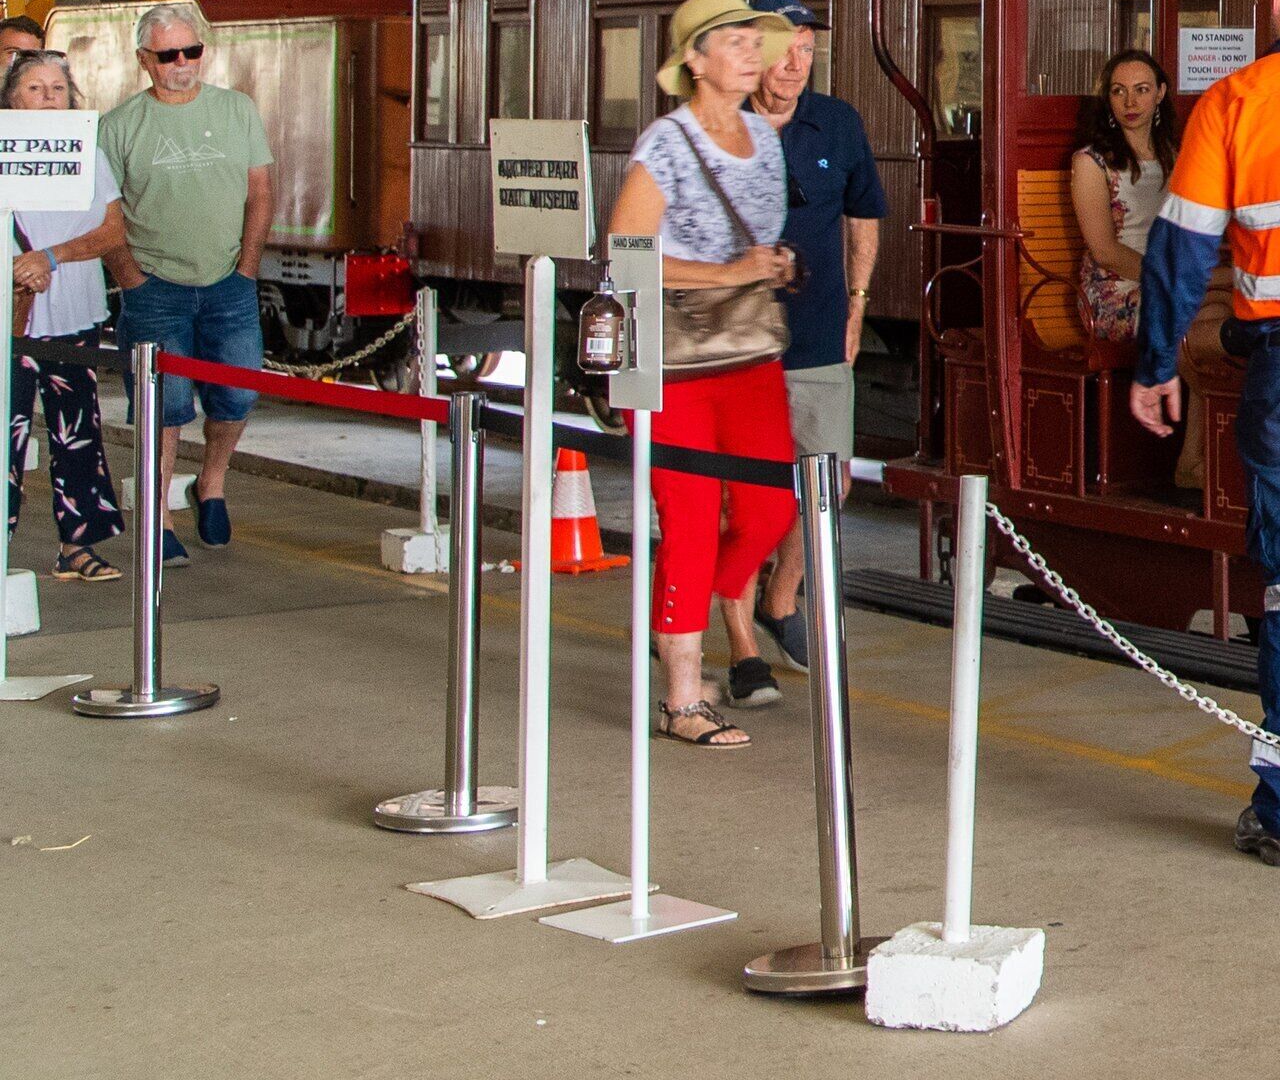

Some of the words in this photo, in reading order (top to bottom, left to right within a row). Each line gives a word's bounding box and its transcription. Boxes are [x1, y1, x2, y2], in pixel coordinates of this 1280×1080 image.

[1191, 33, 1204, 42] NO
[1205, 33, 1244, 42] STANDING
[1187, 54, 1217, 62] DANGER
[1221, 54, 1232, 62] DO
[1233, 54, 1248, 62] NOT
[1187, 66, 1212, 74] TOUCH
[1212, 66, 1227, 74] BELL
[25, 138, 83, 153] PARK
[498, 159, 544, 179] ARCHER
[547, 160, 579, 180] PARK
[499, 187, 526, 206] RAIL
[528, 189, 580, 210] MUSEUM
[613, 236, 628, 248] HAND
[628, 236, 654, 249] SANITISER
